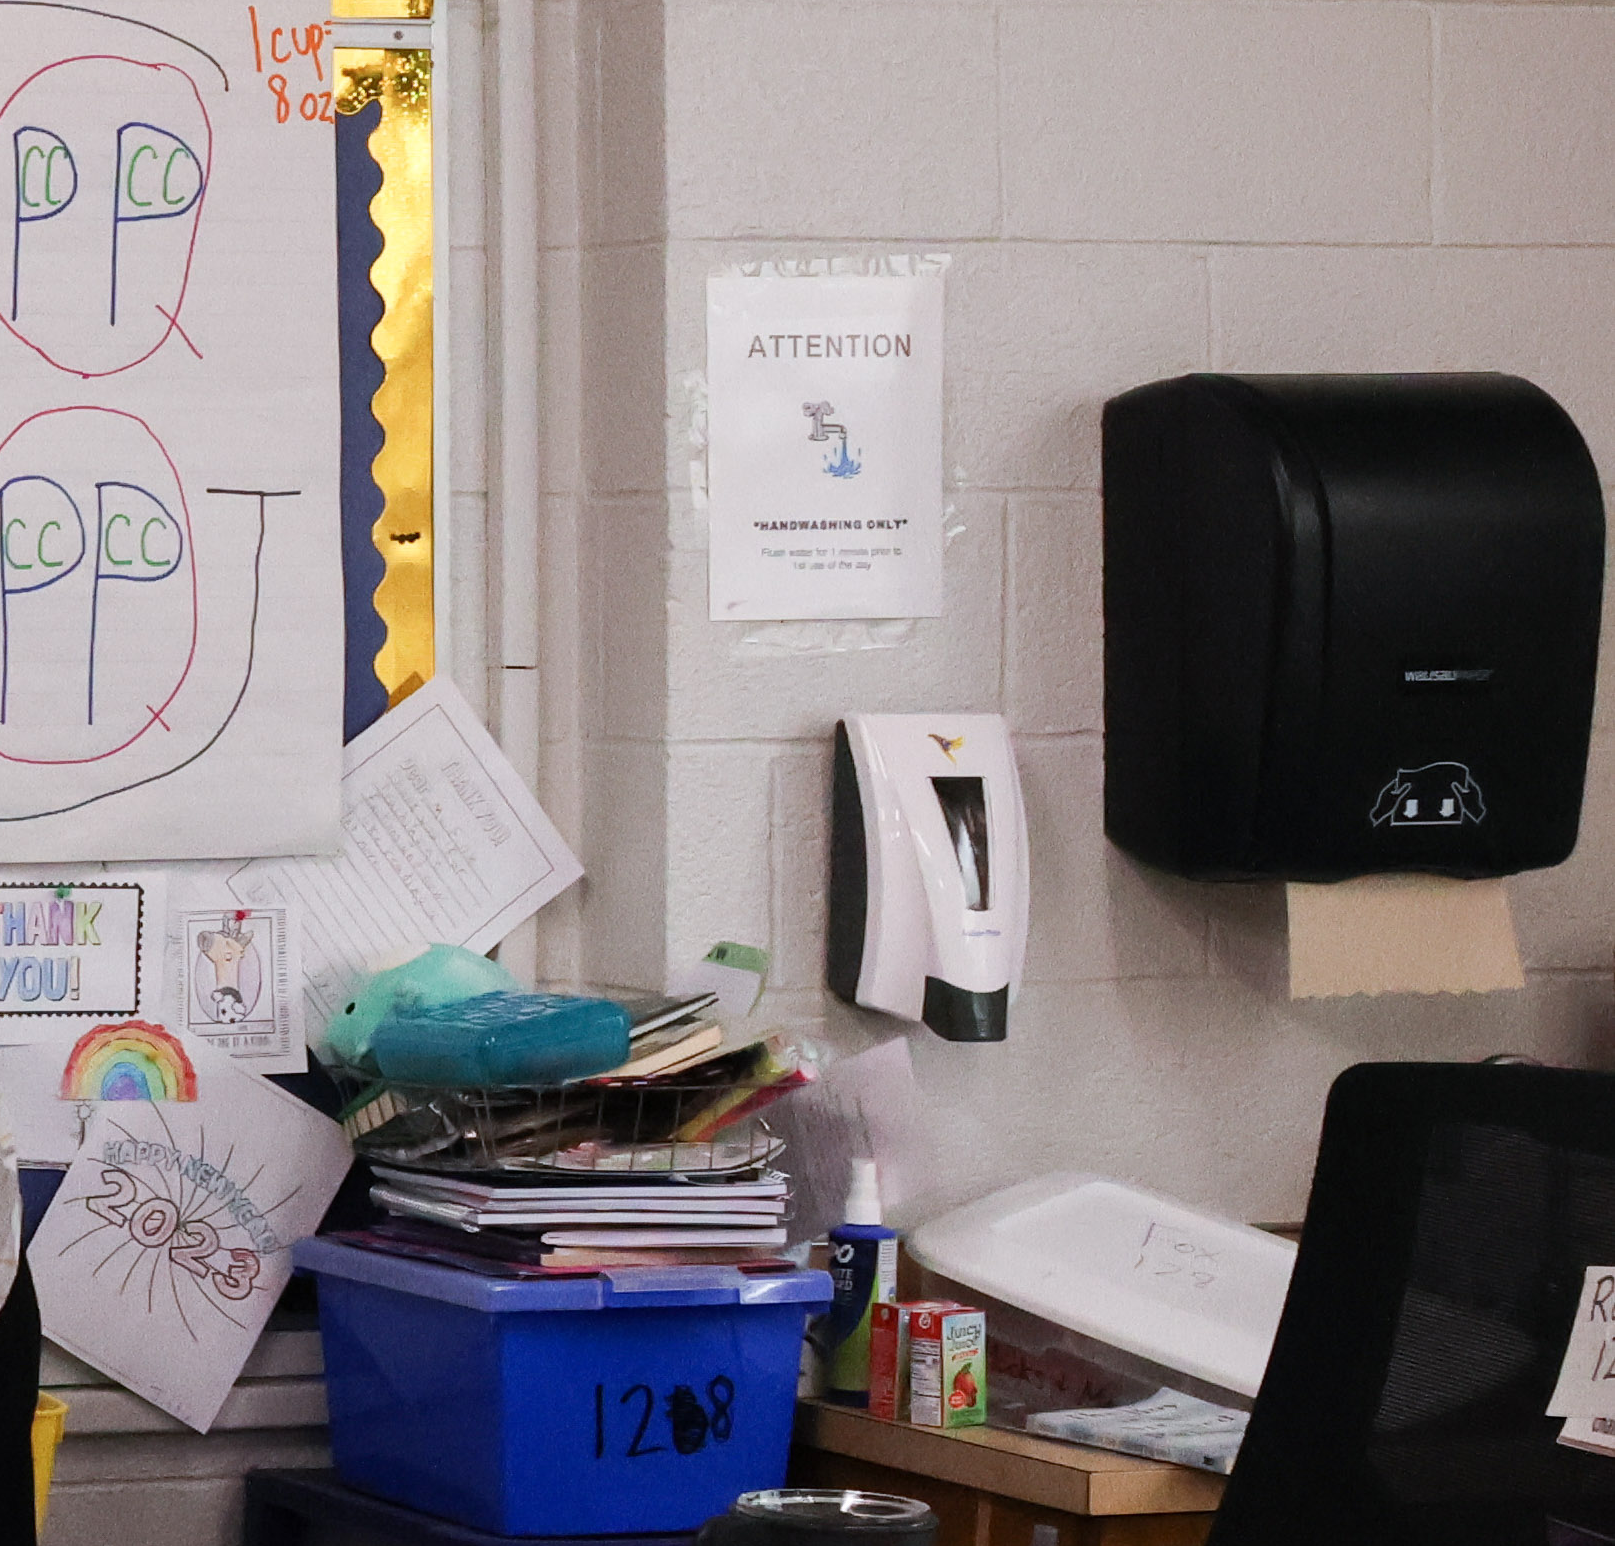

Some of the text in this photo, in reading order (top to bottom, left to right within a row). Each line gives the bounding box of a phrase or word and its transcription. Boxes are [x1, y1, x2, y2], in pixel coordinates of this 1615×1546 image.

[268, 74, 291, 125] 8
[747, 333, 912, 359] ATTENTION
[103, 1138, 182, 1172] HAPPY
[85, 1168, 261, 1301] 2023
